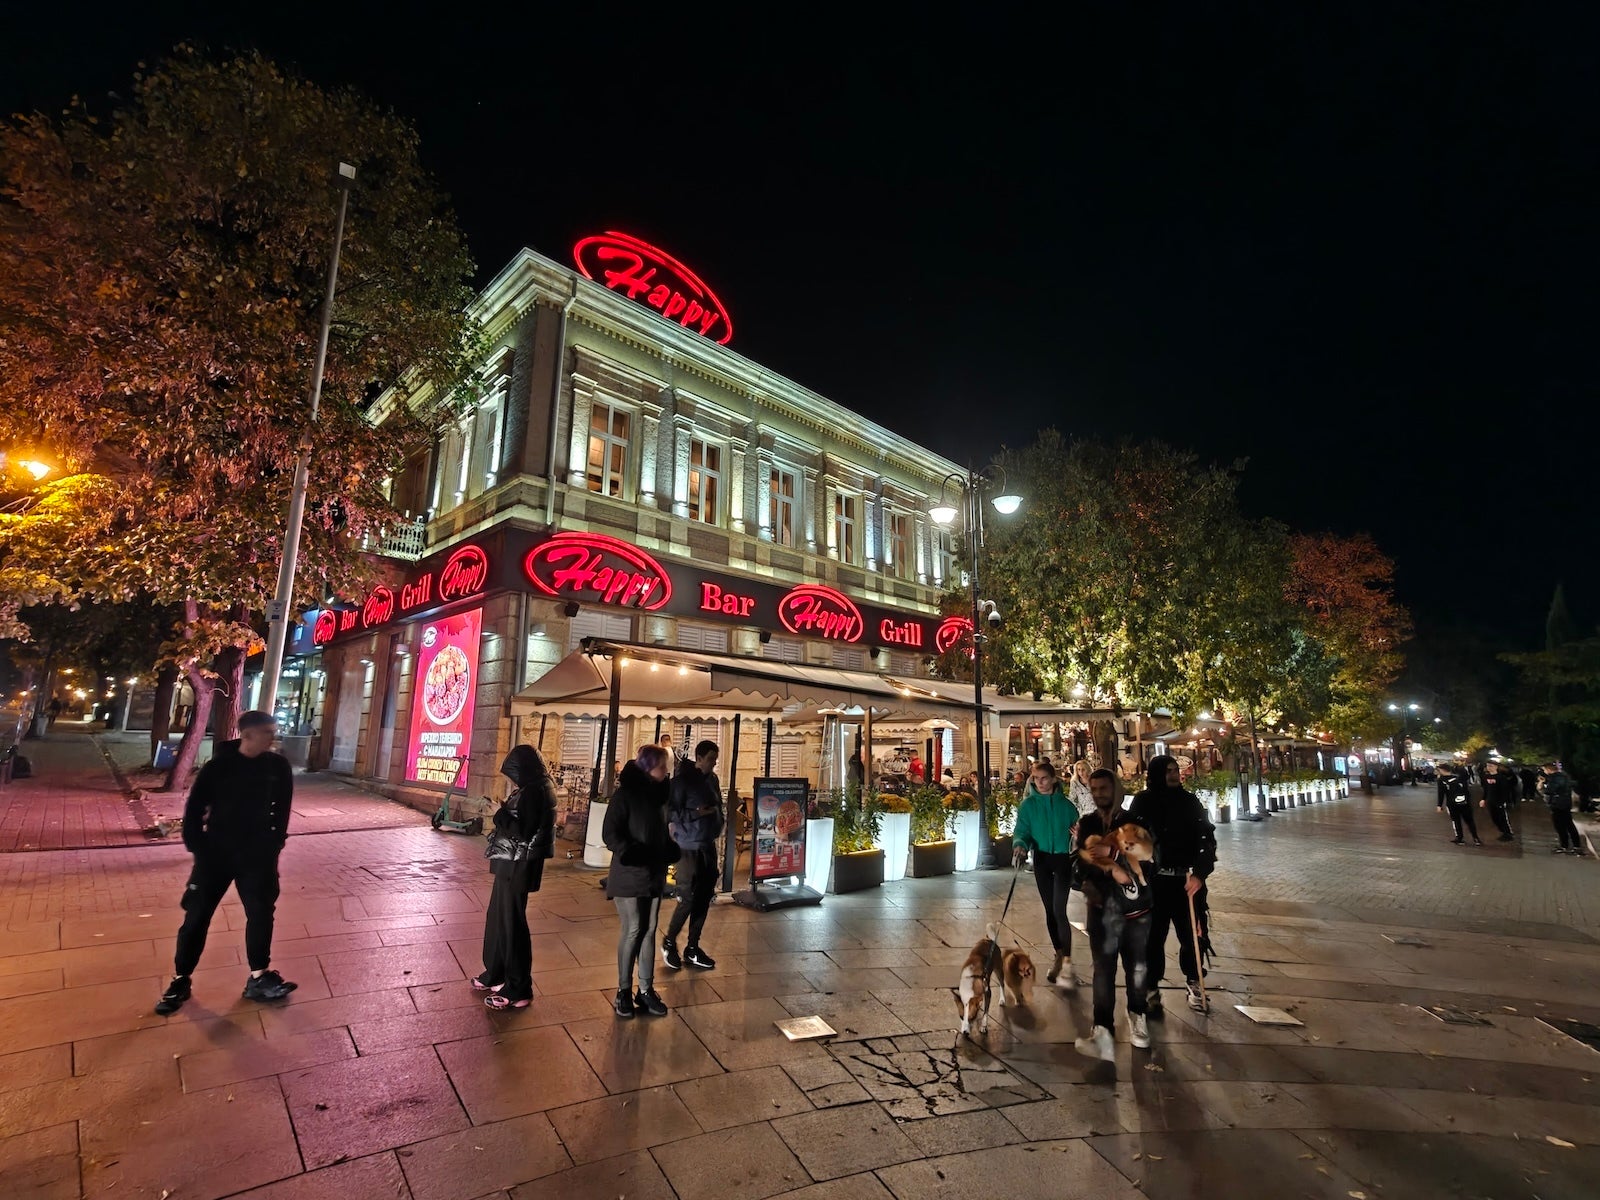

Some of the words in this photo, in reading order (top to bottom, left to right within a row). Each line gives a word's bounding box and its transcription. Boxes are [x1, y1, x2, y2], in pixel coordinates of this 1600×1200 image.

[597, 246, 720, 336] Happy
[339, 608, 359, 632] Bar
[401, 573, 432, 610] Grill
[444, 560, 483, 597] Happy
[545, 546, 662, 608] Happy
[699, 581, 756, 618] Bar
[789, 596, 857, 643] Happy
[880, 618, 923, 648] Grill
